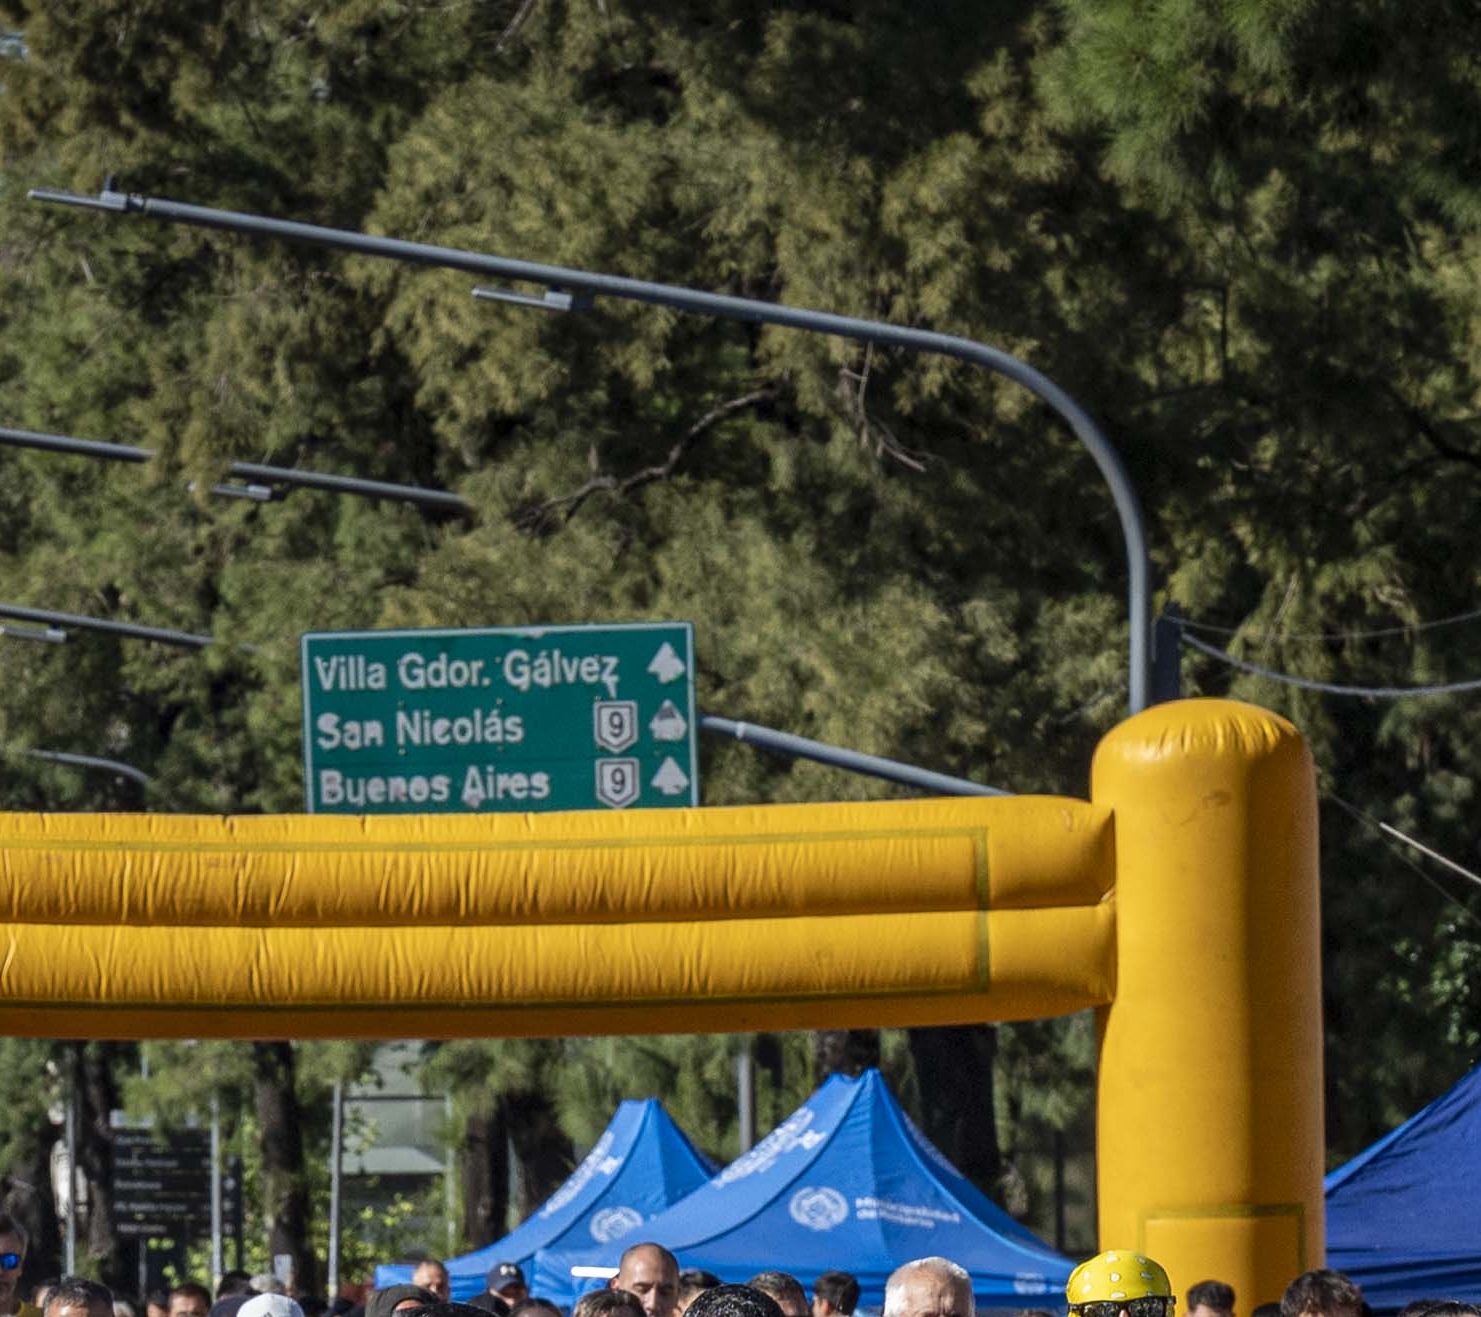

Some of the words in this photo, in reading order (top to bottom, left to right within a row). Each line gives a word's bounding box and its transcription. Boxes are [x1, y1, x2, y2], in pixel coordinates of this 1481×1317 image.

[315, 656, 386, 691] Villa
[398, 652, 490, 690] Gdor.
[502, 649, 619, 692] Gálvez
[317, 712, 384, 749] San
[396, 707, 524, 746] Nicolás
[609, 711, 625, 738] 9
[318, 769, 450, 805] Buenos
[461, 766, 550, 803] Aires
[610, 767, 627, 794] 9
